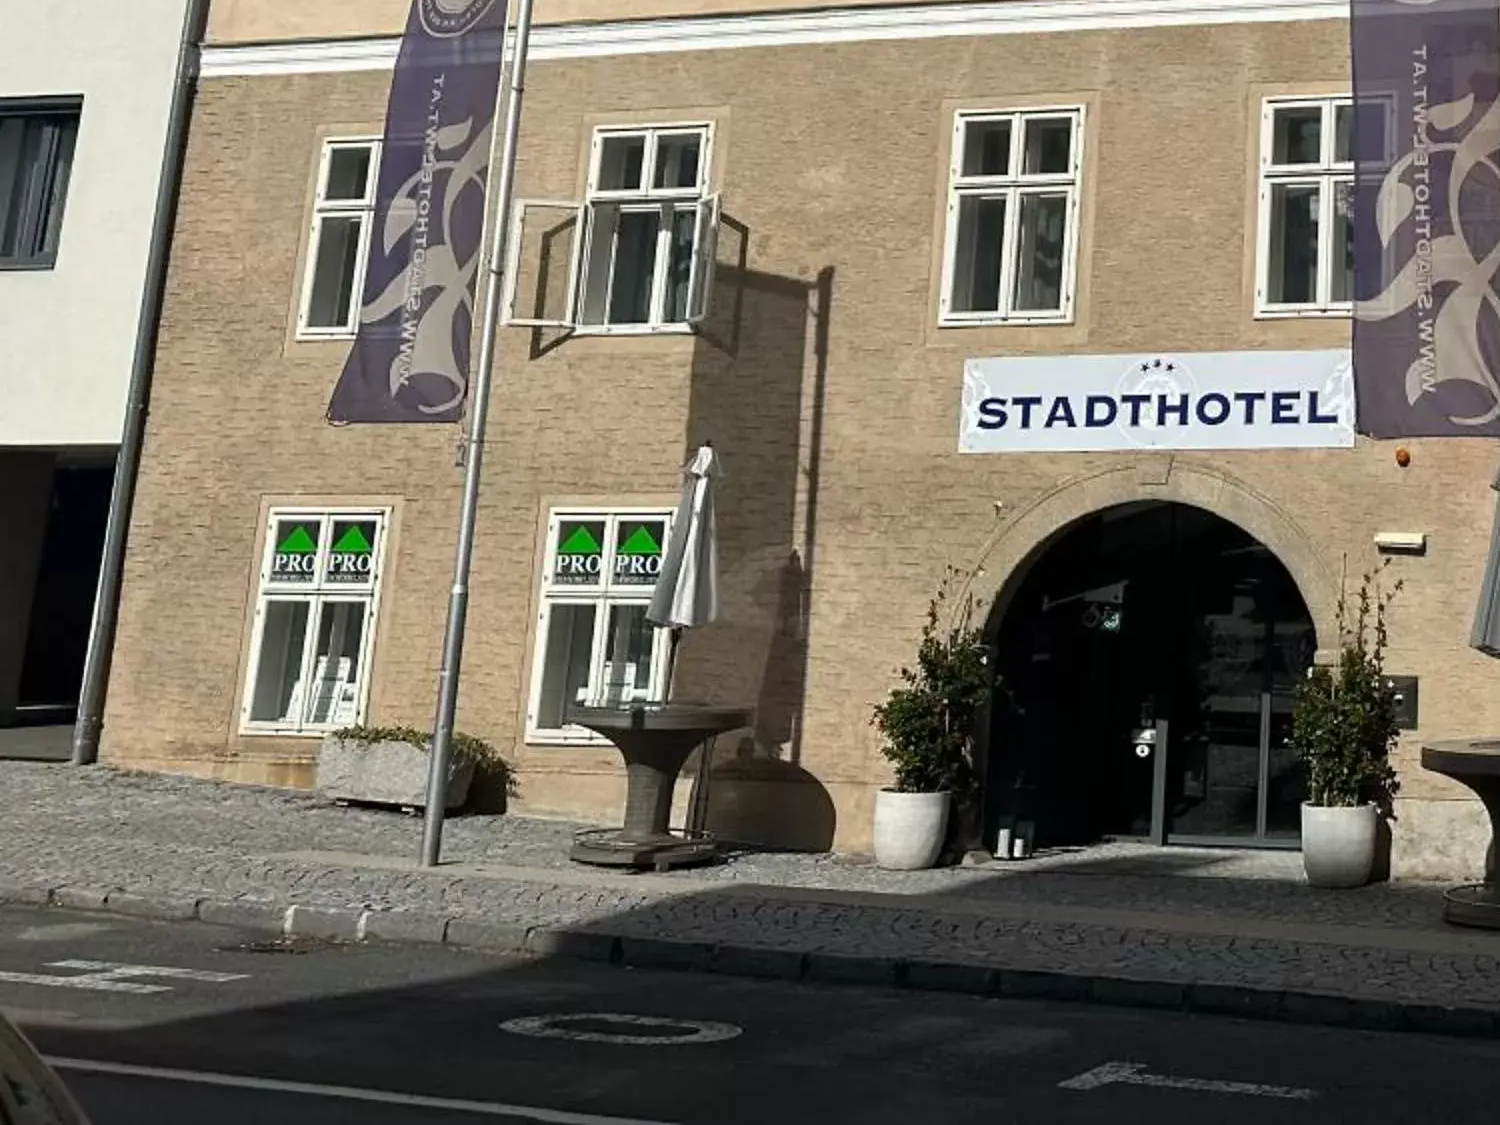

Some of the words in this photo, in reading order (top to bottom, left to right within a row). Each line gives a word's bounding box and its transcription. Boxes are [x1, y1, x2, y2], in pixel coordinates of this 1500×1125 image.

[976, 390, 1338, 430] STADTHOTEL
[273, 553, 316, 572] PRO
[328, 553, 371, 572] PRO
[556, 554, 600, 574] PRO
[615, 554, 661, 574] PRO
